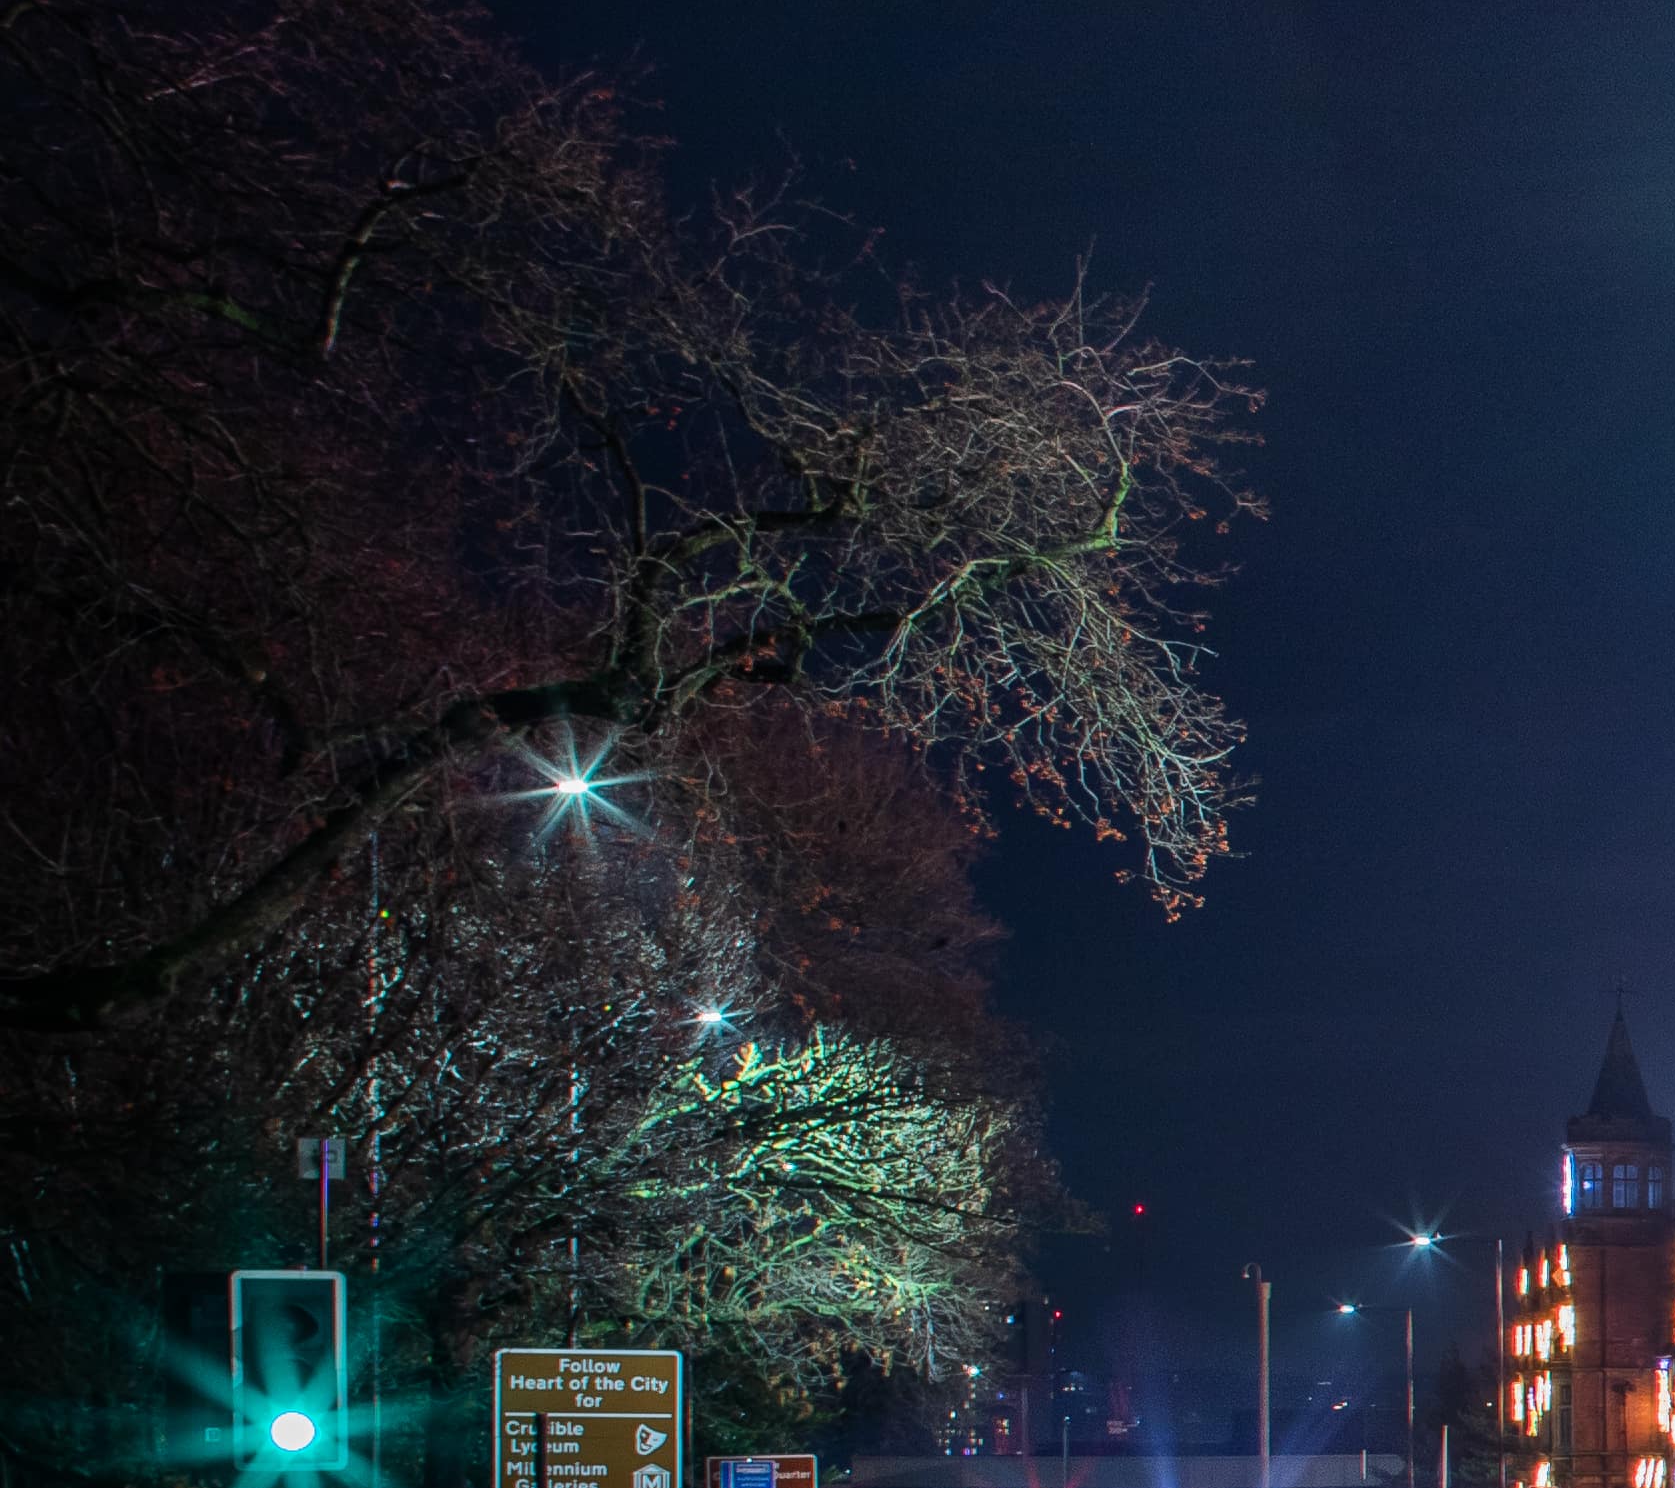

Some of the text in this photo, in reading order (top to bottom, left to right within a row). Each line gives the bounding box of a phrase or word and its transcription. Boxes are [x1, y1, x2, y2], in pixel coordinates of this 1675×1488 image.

[559, 1358, 621, 1374] Follow
[510, 1375, 669, 1394] Heart of the City
[575, 1393, 603, 1408] for
[505, 1420, 584, 1436] Cruible
[507, 1461, 608, 1477] Milennium
